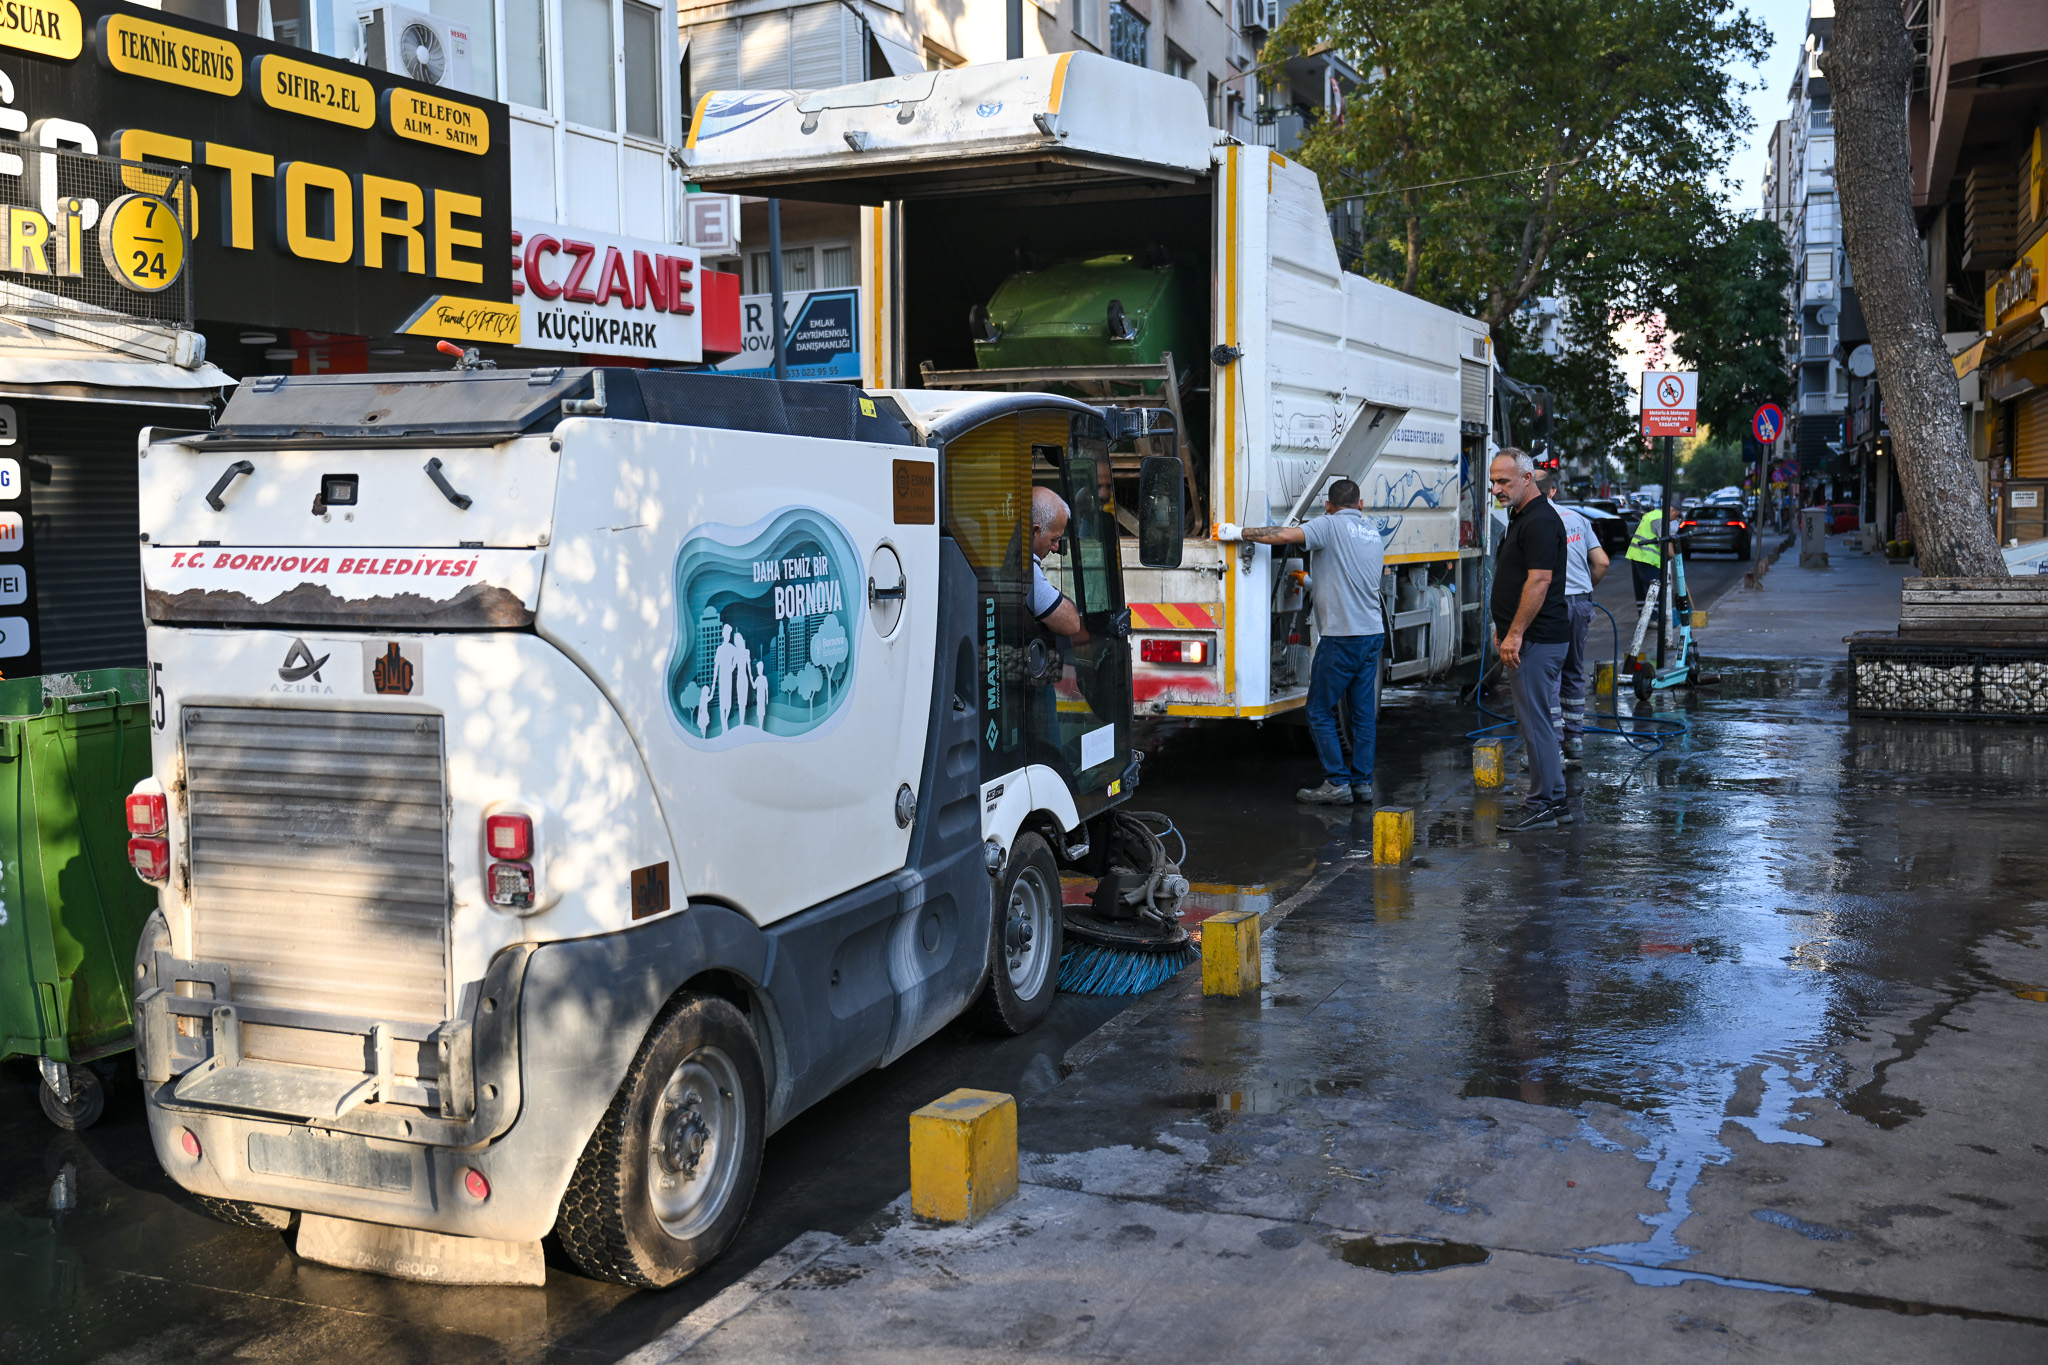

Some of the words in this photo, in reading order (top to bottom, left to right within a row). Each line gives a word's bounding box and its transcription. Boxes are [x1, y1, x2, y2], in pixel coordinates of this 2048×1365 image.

[119, 30, 178, 69] TEKNİK
[182, 44, 234, 82] SERVİS
[277, 71, 361, 113] SIFIR-2.EL
[410, 98, 472, 128] TELEFON
[403, 118, 432, 136] ALIM
[446, 128, 478, 147] SATIM
[120, 128, 484, 284] STORE
[142, 201, 158, 228] 7
[132, 250, 167, 280] 24
[537, 310, 657, 349] KÜÇÜKPARK
[796, 329, 849, 341] GAYRİMENKUL
[810, 319, 835, 329] EMLAK
[796, 339, 850, 353] DANIŞMANLIĞI
[170, 552, 205, 569] T.C.
[213, 553, 329, 575] BORNOVA
[336, 553, 479, 578] BELEDİYESİ
[753, 559, 780, 583] DAHA
[782, 552, 811, 579] TEMİZ
[813, 551, 829, 576] BİR
[774, 580, 843, 620] BORNOVA
[985, 597, 997, 711] MATHIEU
[394, 1257, 440, 1278] GROUP
